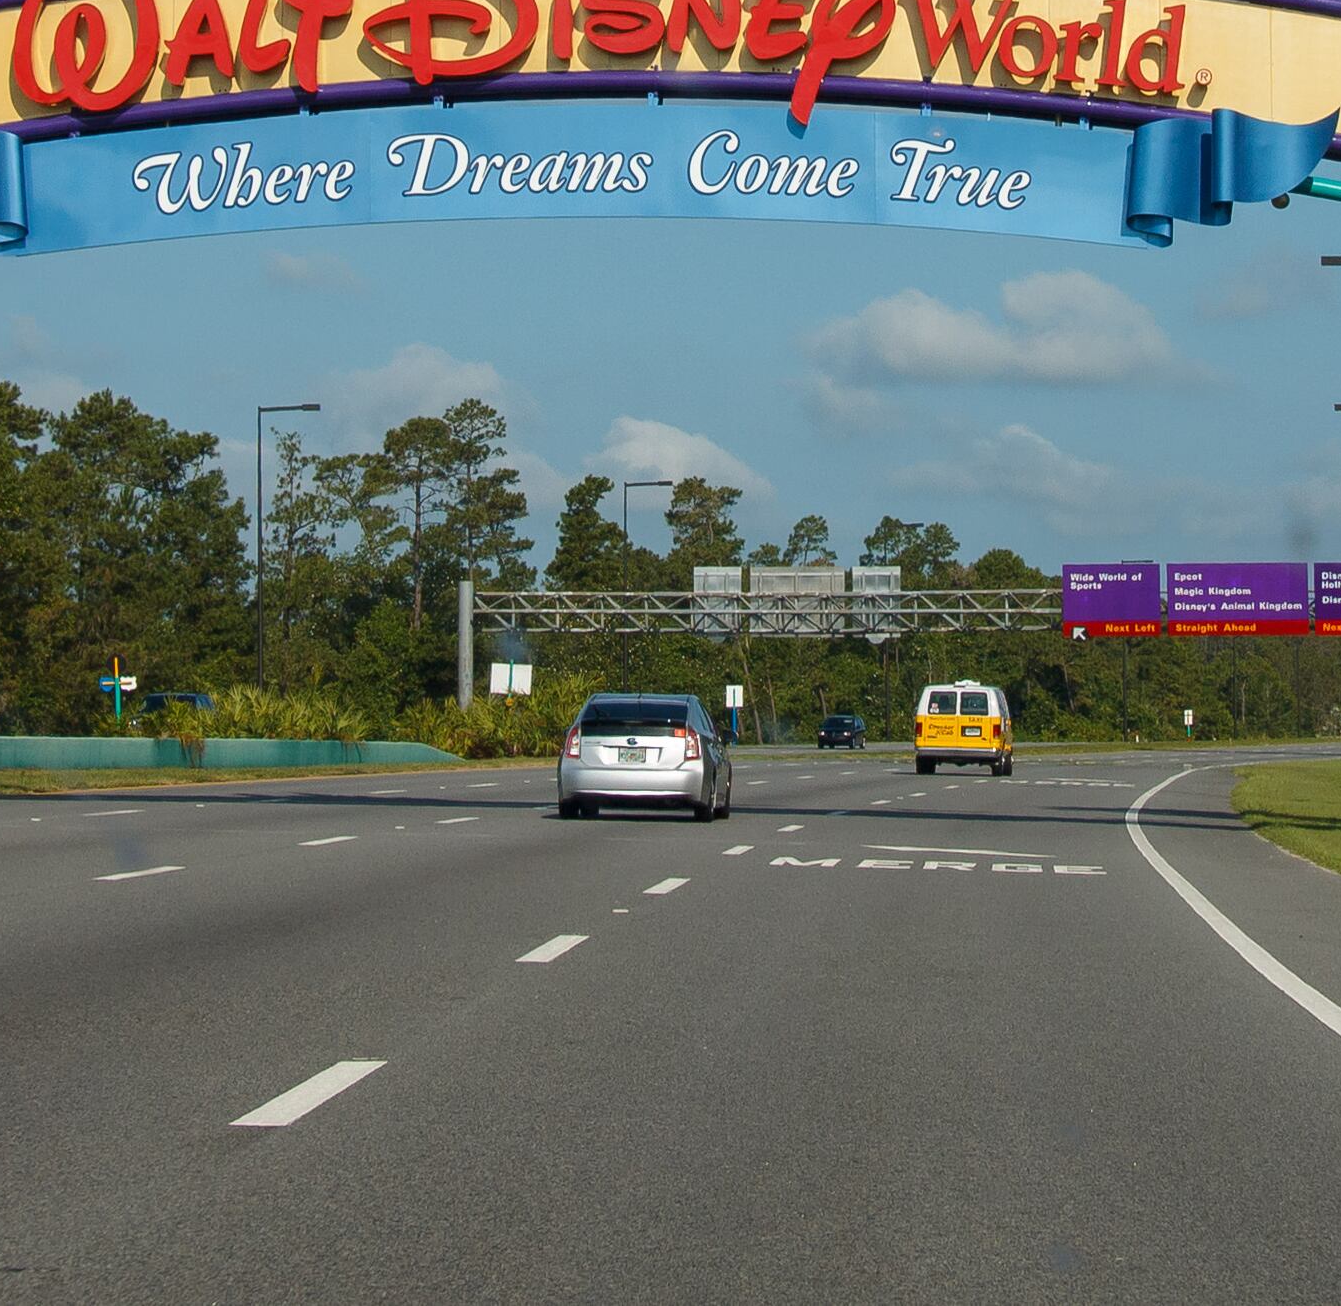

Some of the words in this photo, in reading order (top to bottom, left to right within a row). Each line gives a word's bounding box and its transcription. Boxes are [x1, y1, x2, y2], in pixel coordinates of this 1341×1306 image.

[133, 140, 355, 215] Where
[386, 131, 654, 198] Dreams
[687, 129, 859, 199] Come
[889, 137, 1031, 210] True
[1070, 573, 1094, 582] Wide
[1099, 573, 1127, 582] World
[1131, 572, 1142, 582] of
[1174, 572, 1202, 582] Epcot
[1070, 582, 1102, 591] Sports
[1174, 587, 1204, 597] Magic
[1208, 587, 1251, 596] Kingdom
[1174, 602, 1216, 612] Disney's
[1221, 602, 1255, 611] Animal
[1259, 602, 1302, 612] Kingdom
[1105, 624, 1130, 633] Next
[1134, 624, 1156, 632] Left
[1175, 623, 1218, 633] Straight
[1223, 623, 1257, 632] Ahead
[769, 856, 1107, 876] MERGE
